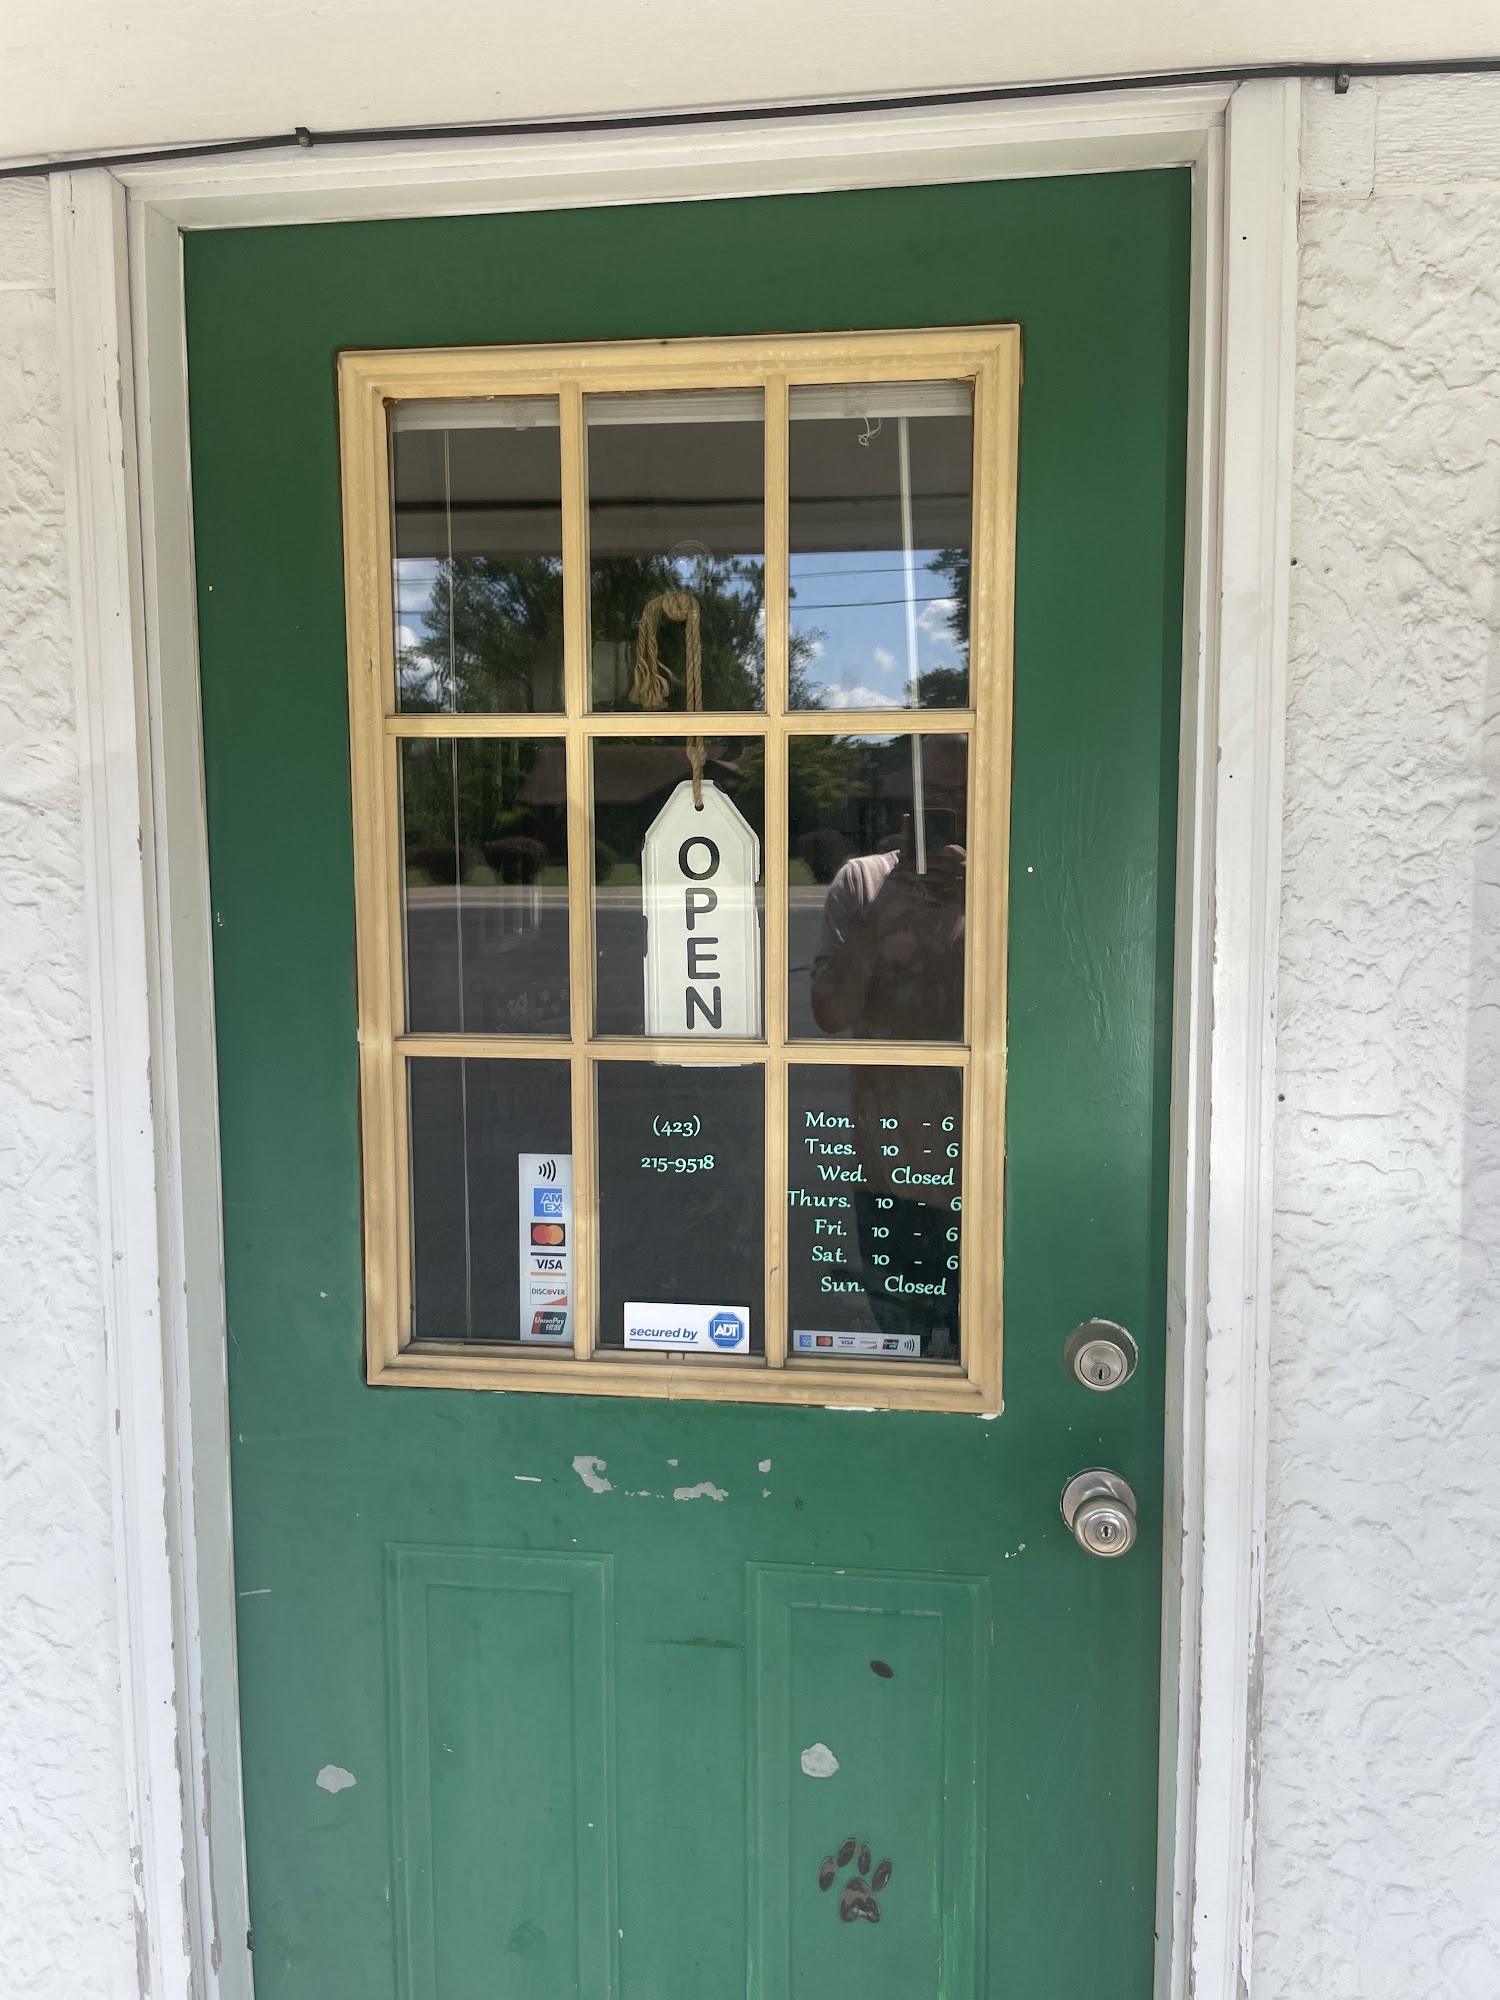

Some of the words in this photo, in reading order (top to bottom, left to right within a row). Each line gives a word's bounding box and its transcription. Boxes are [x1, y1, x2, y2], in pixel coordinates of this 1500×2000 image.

[678, 836, 722, 1030] OPEN
[652, 1114, 701, 1137] (423)
[804, 1111, 856, 1129] Mon.
[879, 1118, 899, 1130] 10
[941, 1116, 954, 1132] 6
[804, 1138, 857, 1156] Tues.
[880, 1145, 900, 1157] 10
[946, 1142, 959, 1158] 6
[641, 1154, 715, 1174] 215-9518
[816, 1163, 868, 1183] Wed.
[891, 1165, 955, 1186] Closed
[542, 1193, 562, 1203] AM
[787, 1188, 851, 1208] Thurs.
[875, 1197, 894, 1209] 10
[950, 1196, 962, 1212] 6
[814, 1218, 848, 1236] Fri.
[871, 1226, 890, 1238] 10
[945, 1226, 959, 1242] 6
[535, 1259, 563, 1270] VISA
[811, 1245, 848, 1264] Sat.
[871, 1254, 890, 1266] 10
[946, 1255, 959, 1270] 6
[531, 1288, 566, 1296] DISCOVER
[820, 1275, 865, 1293] Sun.
[884, 1274, 947, 1296] Closed
[534, 1316, 565, 1326] UnionPay
[714, 1321, 738, 1338] ADT
[629, 1326, 681, 1339] secured
[682, 1328, 698, 1341] by
